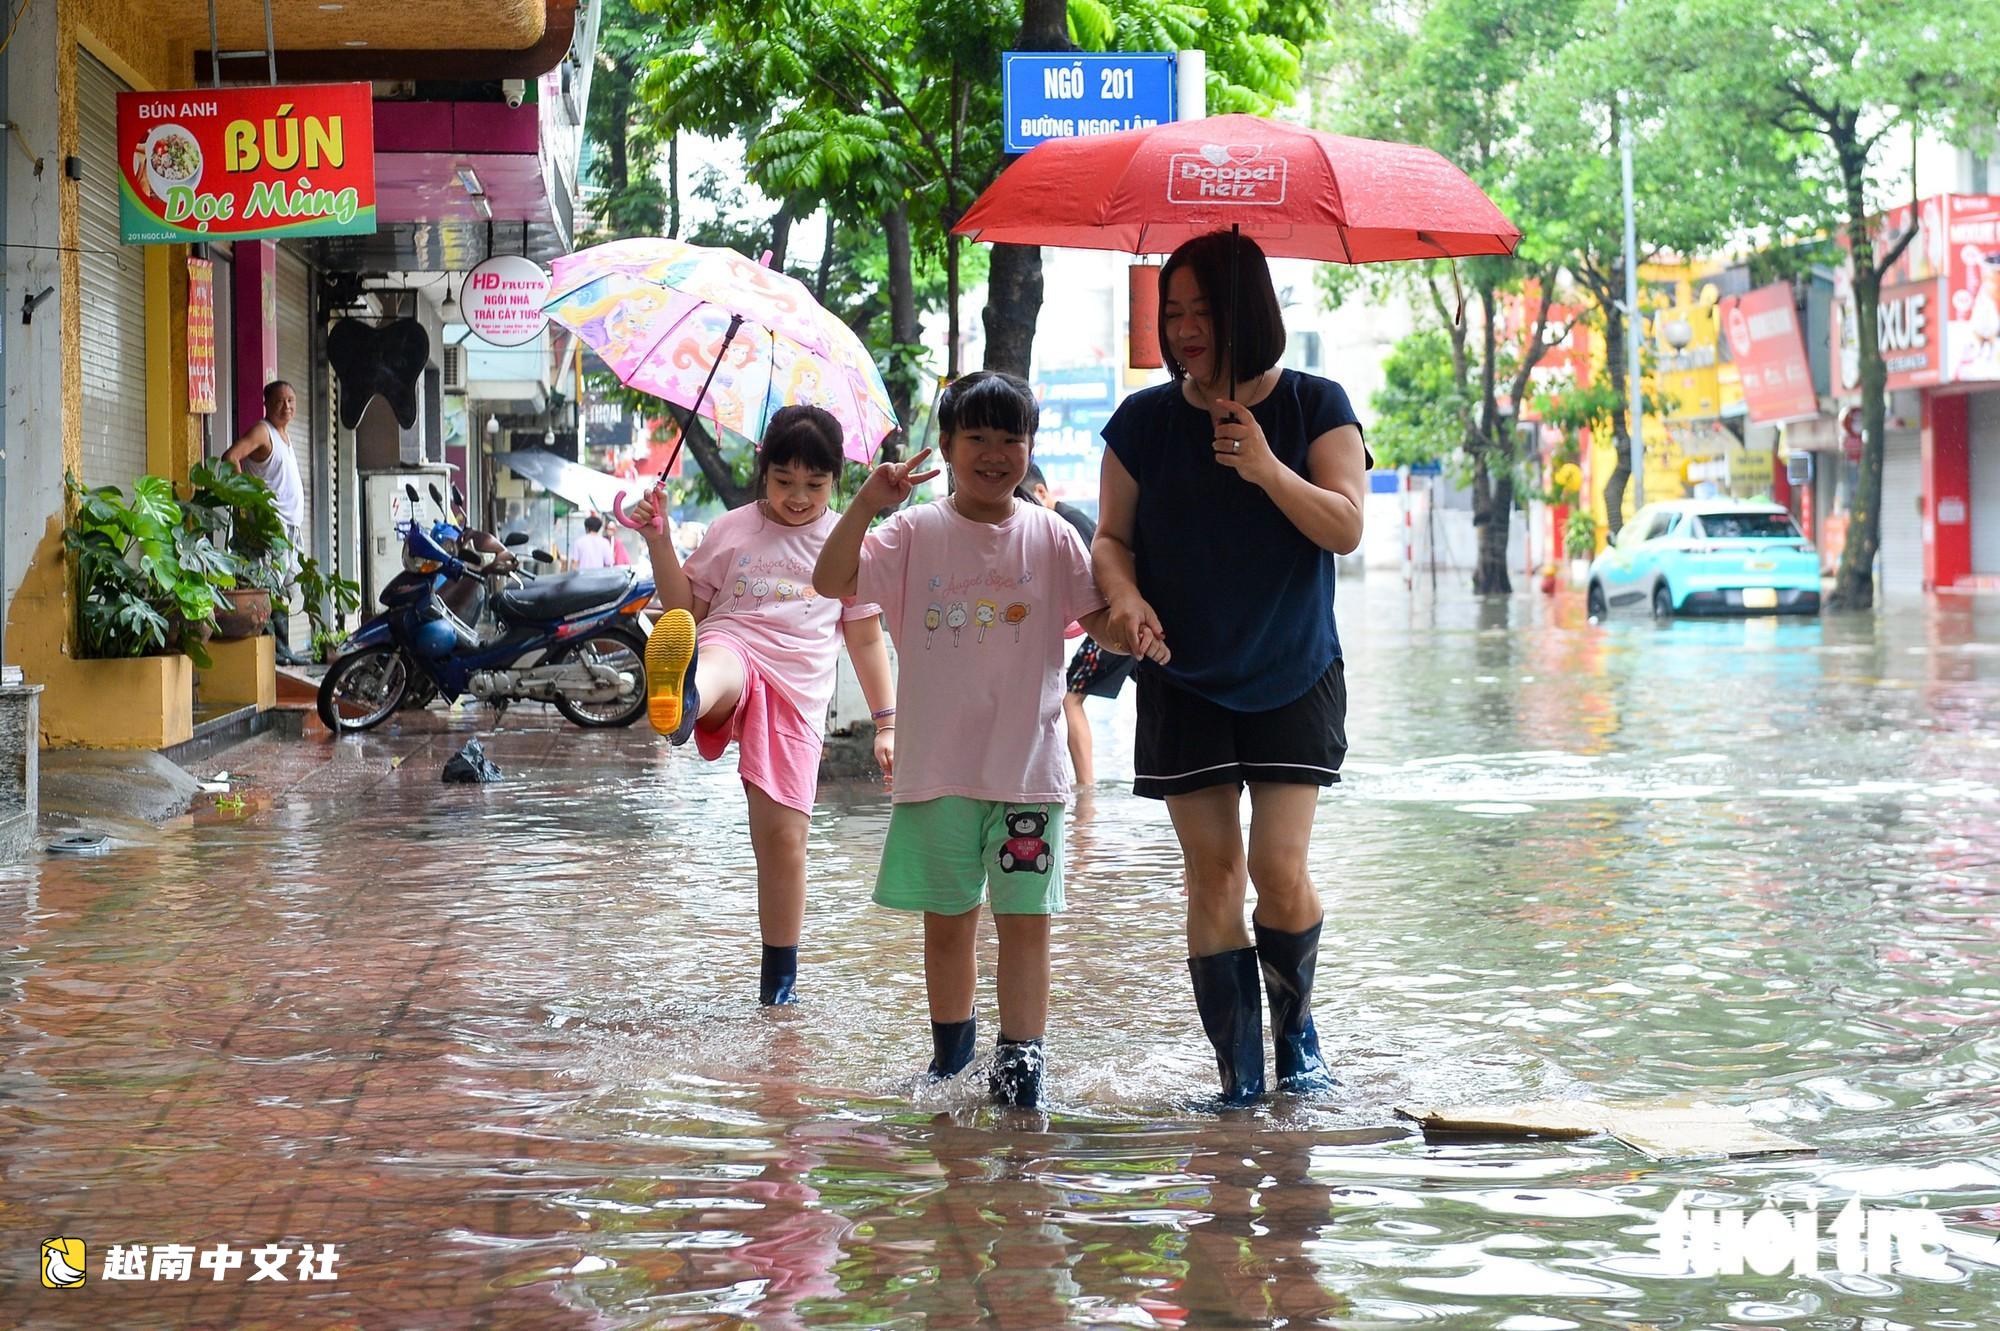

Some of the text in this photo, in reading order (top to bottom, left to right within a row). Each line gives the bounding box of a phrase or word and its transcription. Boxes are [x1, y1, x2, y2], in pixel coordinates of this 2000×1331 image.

[1043, 61, 1134, 100] NGÕ 201
[138, 102, 218, 119] BÚN ANH
[1020, 114, 1074, 138] ĐƯỜNG
[224, 103, 345, 172] BÚN
[1181, 162, 1275, 183] Doppel
[1200, 180, 1256, 197] herz
[164, 177, 358, 233] Dọc Mùng
[127, 233, 140, 241] 201
[472, 273, 544, 290] HĐ FRUITS
[484, 293, 530, 305] NGÔI NHÀ
[474, 308, 495, 320] TRÁI
[498, 307, 516, 320] CÂY
[1876, 293, 1926, 353] IXUE
